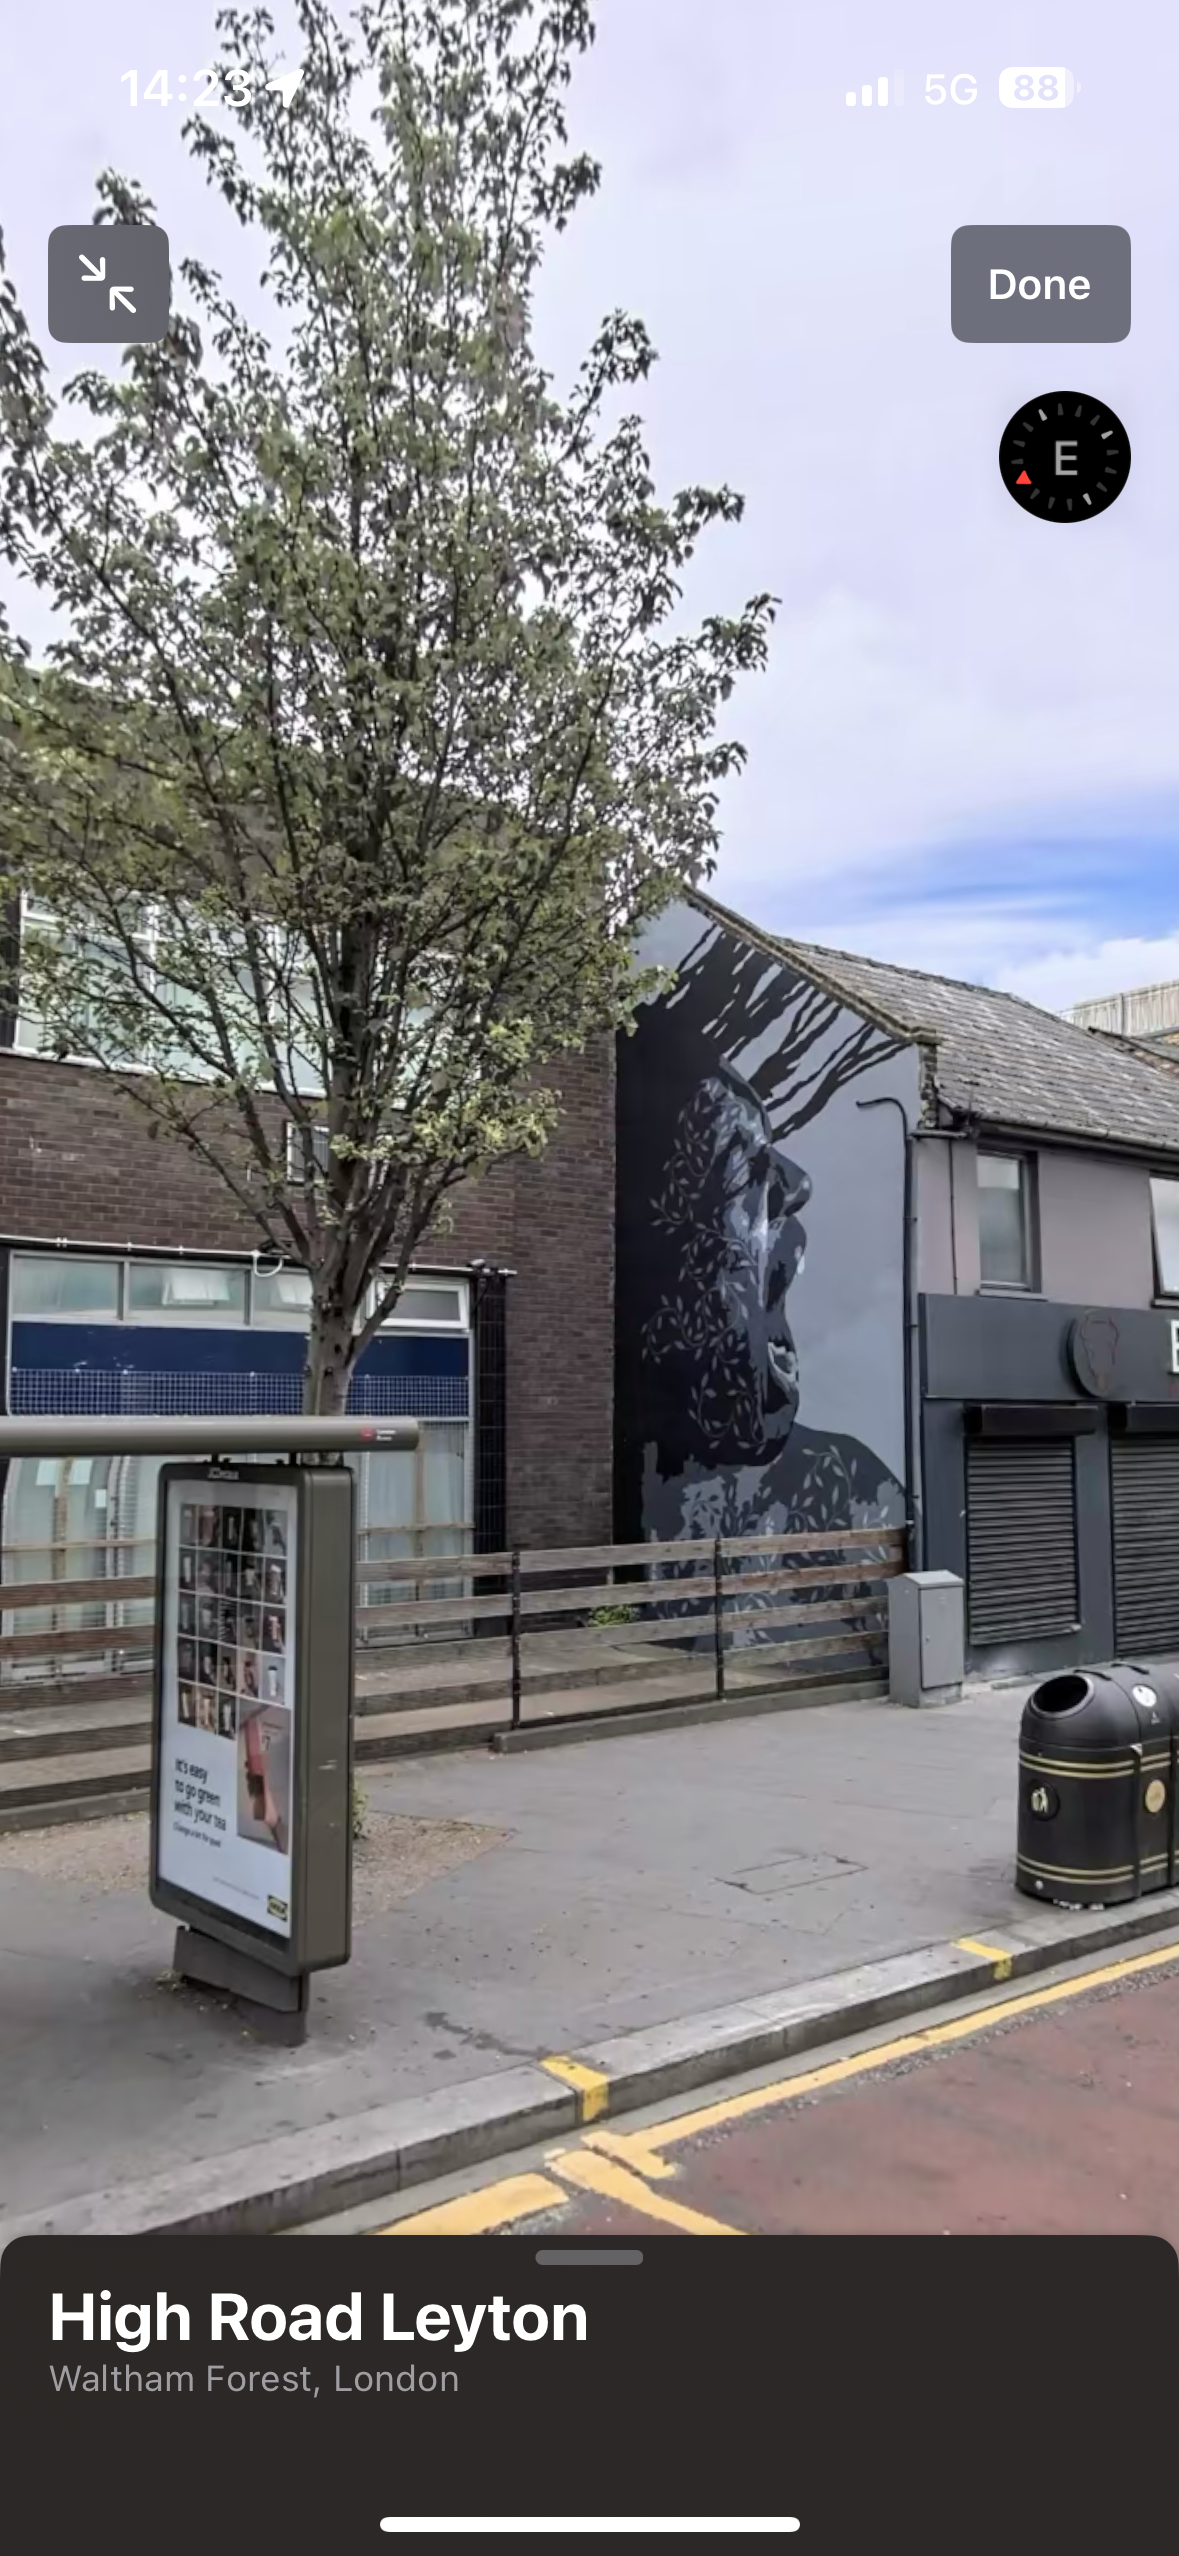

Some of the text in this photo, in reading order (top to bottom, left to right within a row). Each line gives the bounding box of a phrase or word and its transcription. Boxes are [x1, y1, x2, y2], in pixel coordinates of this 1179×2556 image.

[175, 1758, 208, 1785] It's easy
[175, 1780, 221, 1808] to go green
[174, 1801, 226, 1831] with your tea
